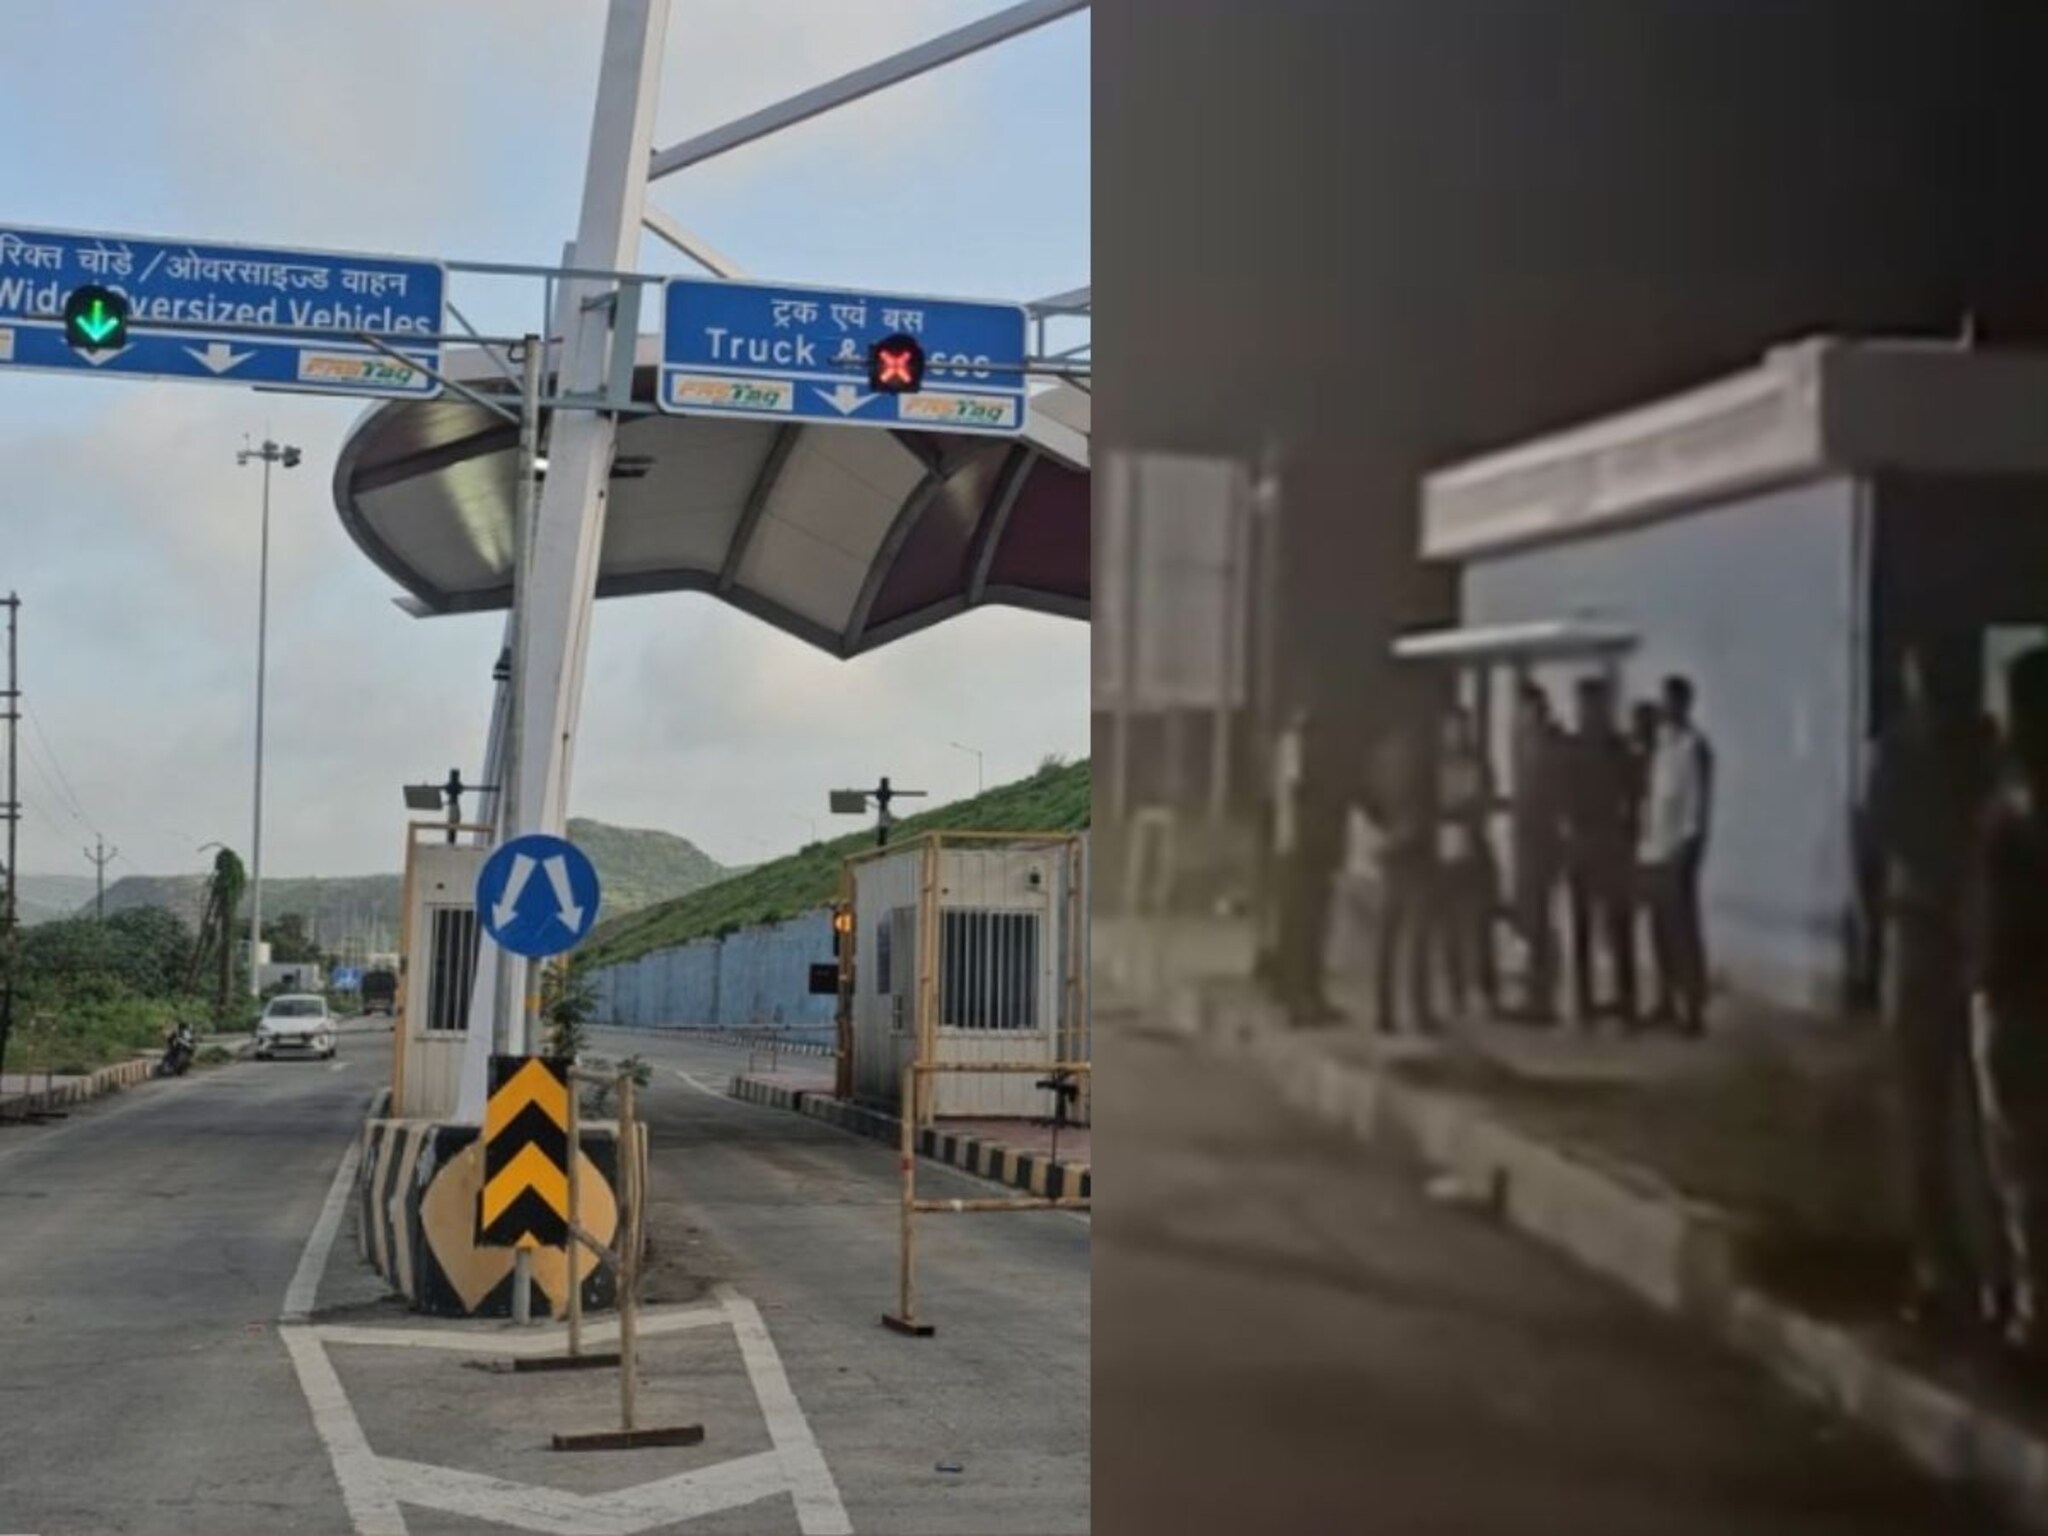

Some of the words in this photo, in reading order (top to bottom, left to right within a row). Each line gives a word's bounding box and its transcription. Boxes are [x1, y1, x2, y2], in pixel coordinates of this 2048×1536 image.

[341, 268, 408, 297] वाहन
[289, 299, 432, 334] Vehicles
[771, 299, 819, 328] ट्रक
[829, 300, 867, 332] एवं
[882, 309, 924, 332] बस
[705, 327, 816, 366] Truck
[930, 352, 990, 379] ses
